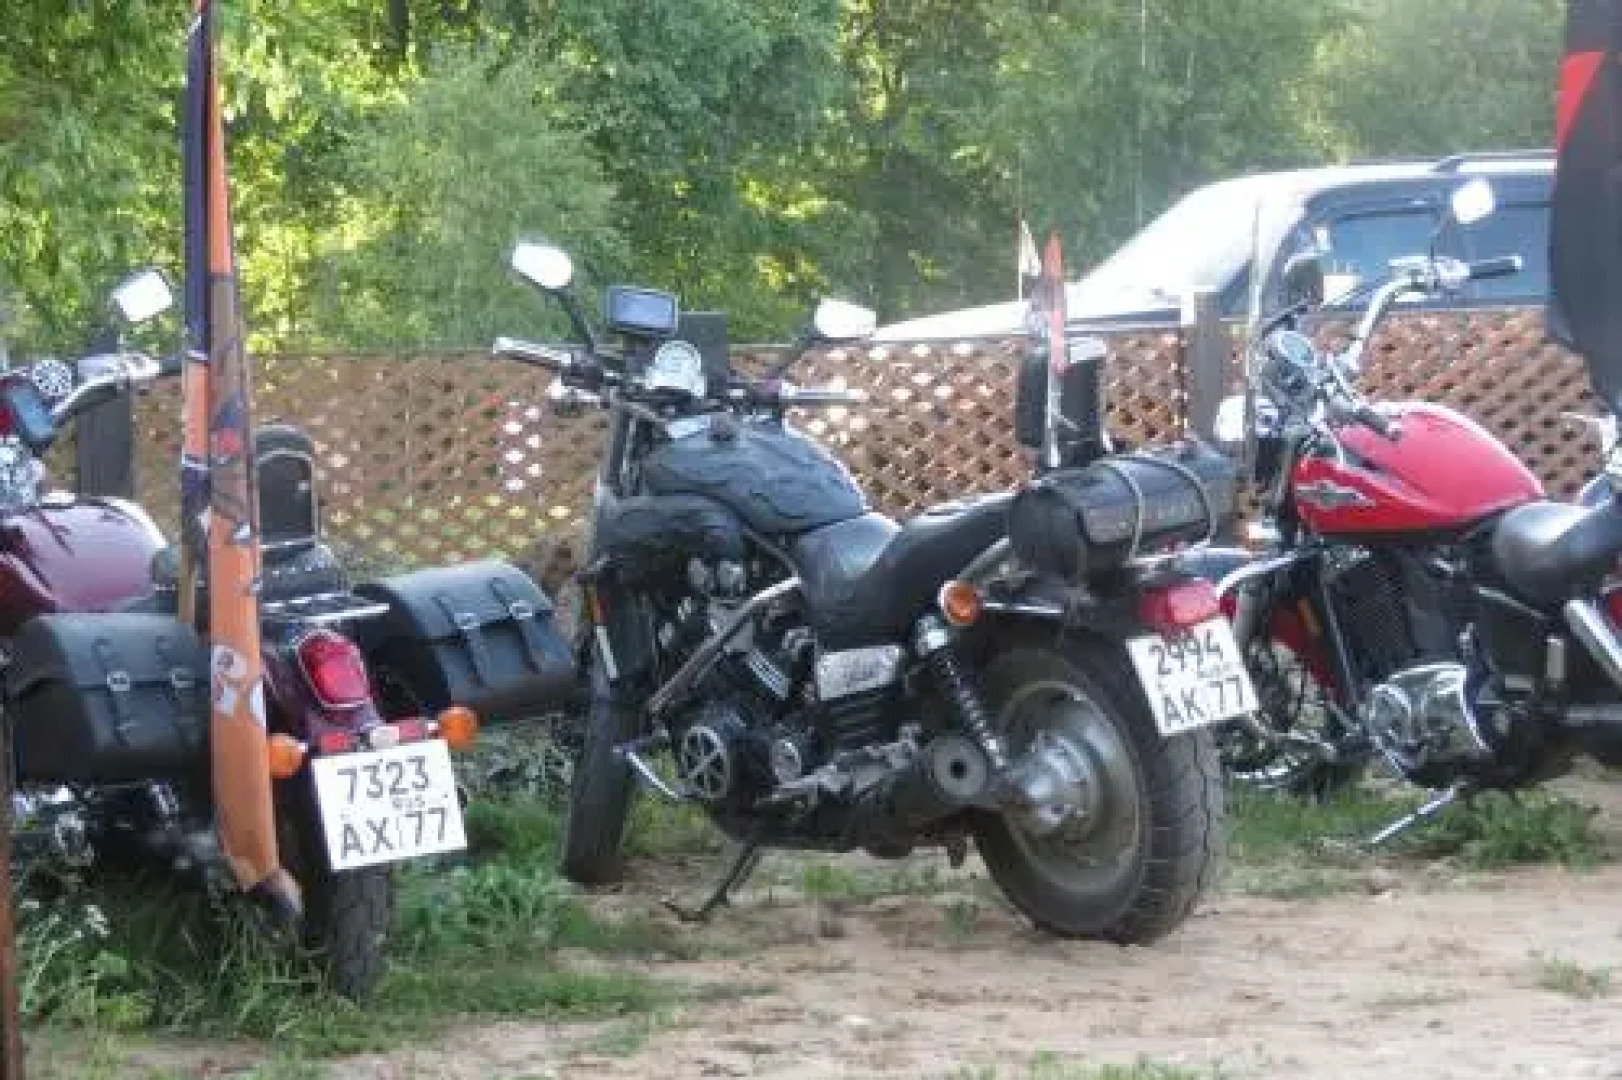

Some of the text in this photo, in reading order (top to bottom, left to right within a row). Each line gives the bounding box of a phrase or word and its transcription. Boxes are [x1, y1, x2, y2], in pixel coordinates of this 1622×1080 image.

[1209, 675, 1243, 714] 77
[336, 755, 429, 805] 7323
[340, 806, 446, 860] AX 77
